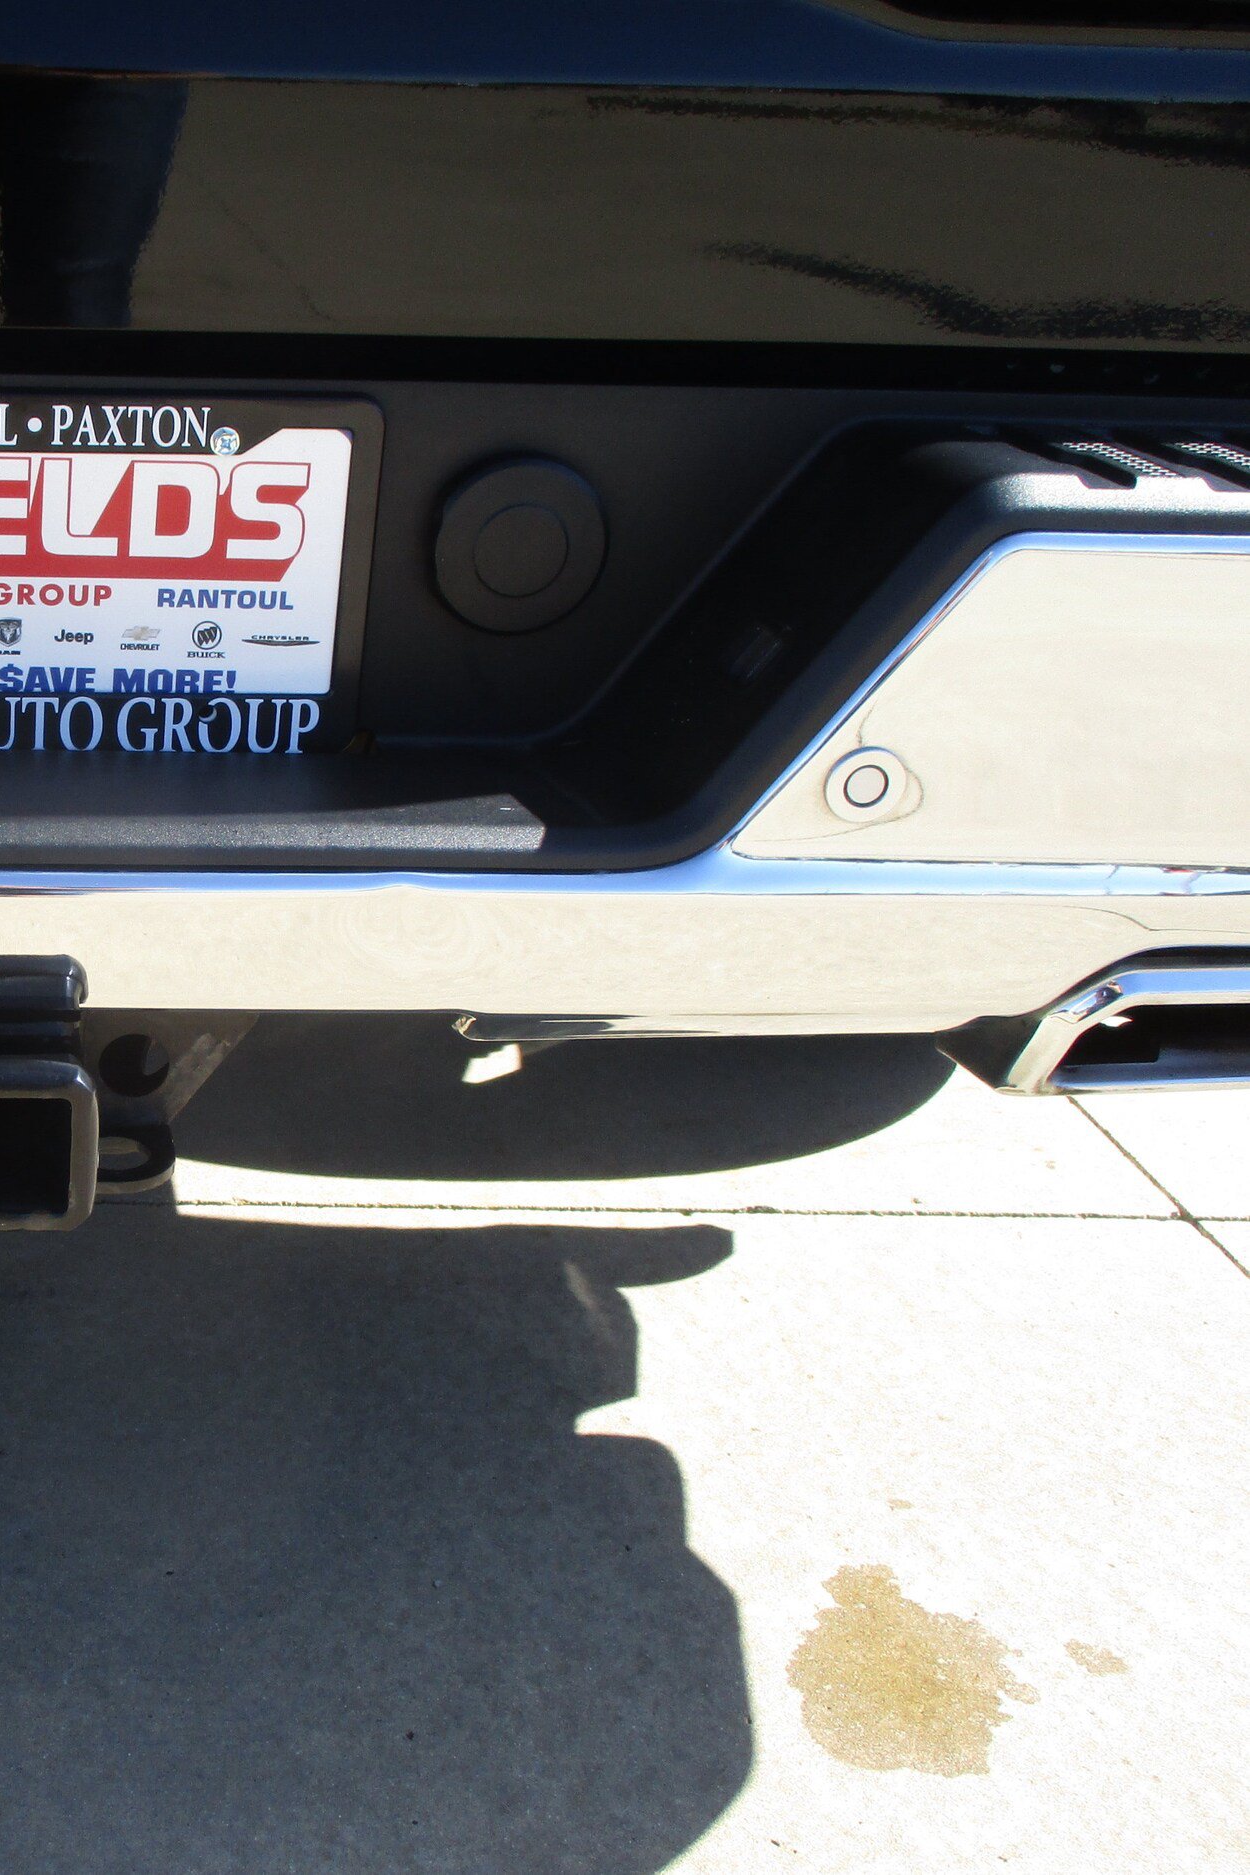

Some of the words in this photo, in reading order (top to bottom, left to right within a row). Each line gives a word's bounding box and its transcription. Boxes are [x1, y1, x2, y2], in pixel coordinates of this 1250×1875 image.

[51, 405, 211, 448] PAXTON
[156, 587, 294, 610] RANTOUL
[53, 628, 94, 645] Jeep
[250, 633, 310, 642] CHRYSLER
[119, 642, 161, 652] CHEVROLET
[186, 650, 226, 659] BUICK
[112, 668, 237, 694] MORE!
[116, 697, 320, 754] GROUP
